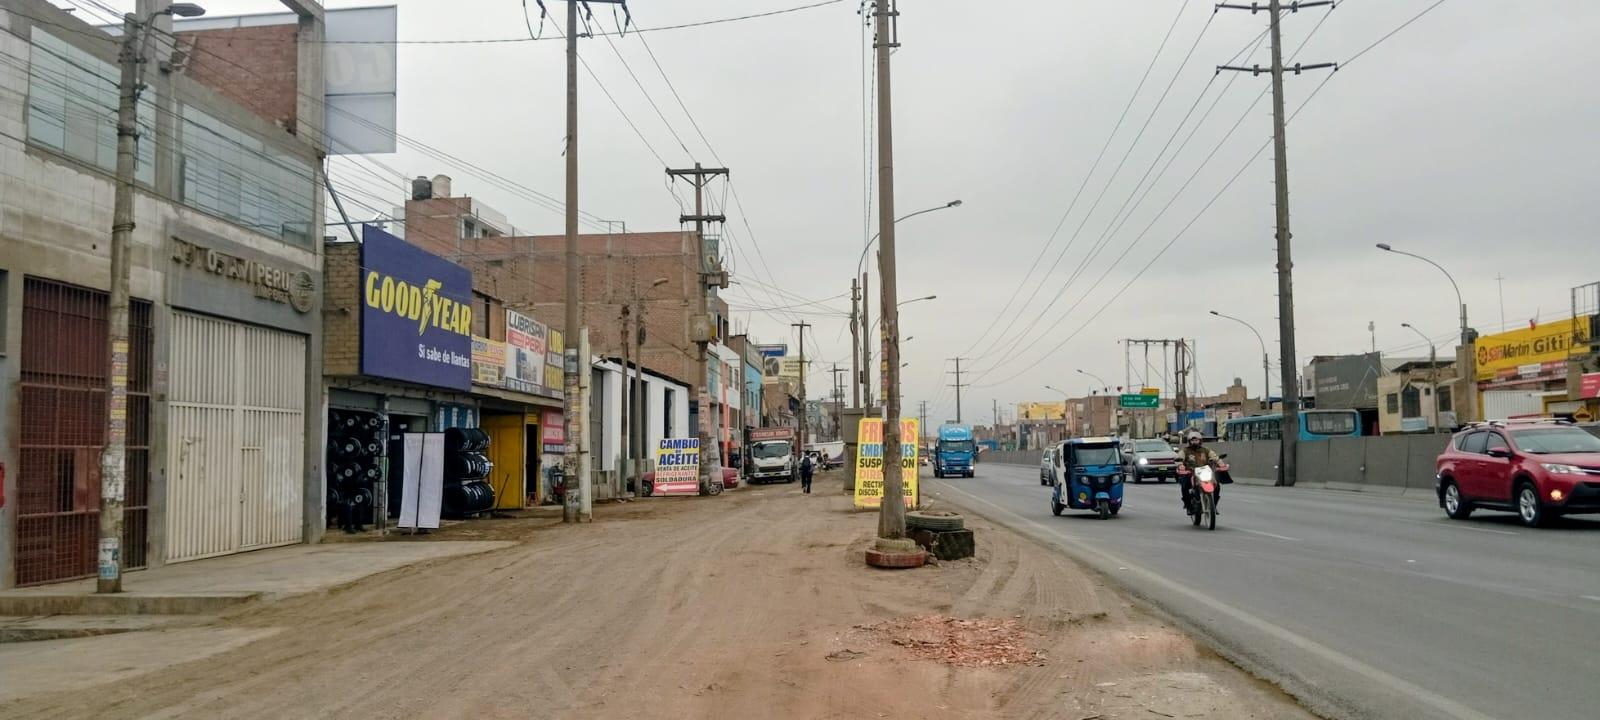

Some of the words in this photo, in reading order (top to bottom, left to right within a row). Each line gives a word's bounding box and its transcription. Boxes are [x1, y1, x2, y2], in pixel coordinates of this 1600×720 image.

[257, 263, 290, 291] PERU
[1533, 334, 1563, 353] Giti
[418, 343, 426, 358] Si
[426, 347, 441, 362] sabe
[442, 351, 451, 365] de
[451, 353, 470, 368] llantas
[660, 439, 699, 449] CAMBIO
[659, 453, 699, 465] ACEITE
